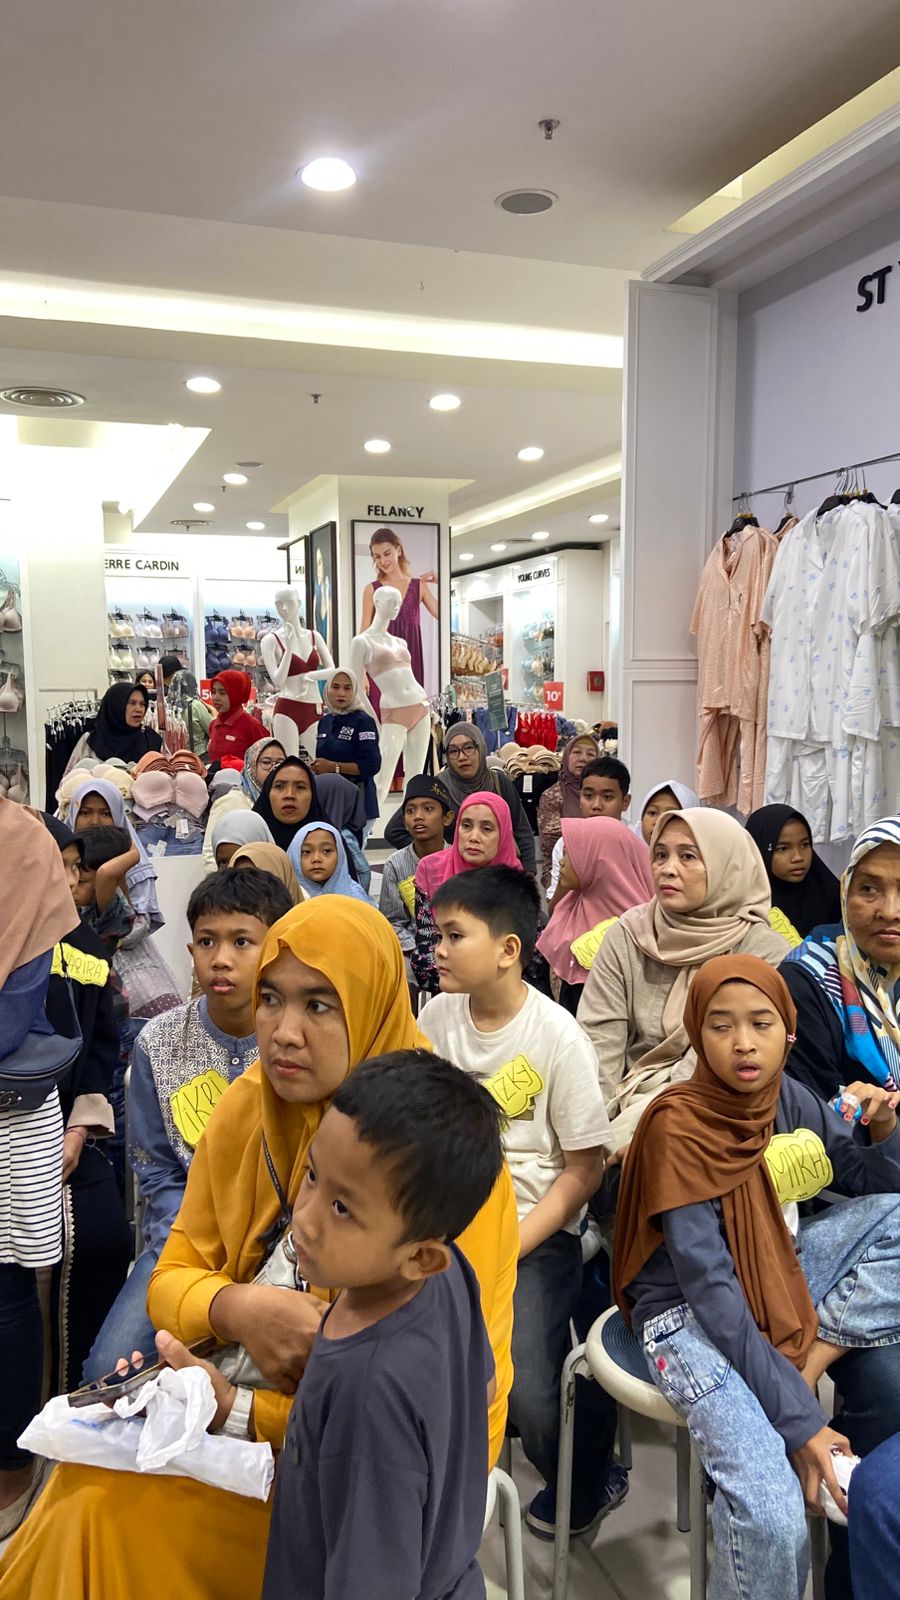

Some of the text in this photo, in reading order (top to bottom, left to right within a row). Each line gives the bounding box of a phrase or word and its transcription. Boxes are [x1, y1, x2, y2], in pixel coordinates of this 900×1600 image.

[367, 504, 424, 518] FELANCY
[135, 560, 179, 571] CARDIN
[517, 568, 551, 583] YOUNG CURVES
[766, 1139, 825, 1194] MIRA
